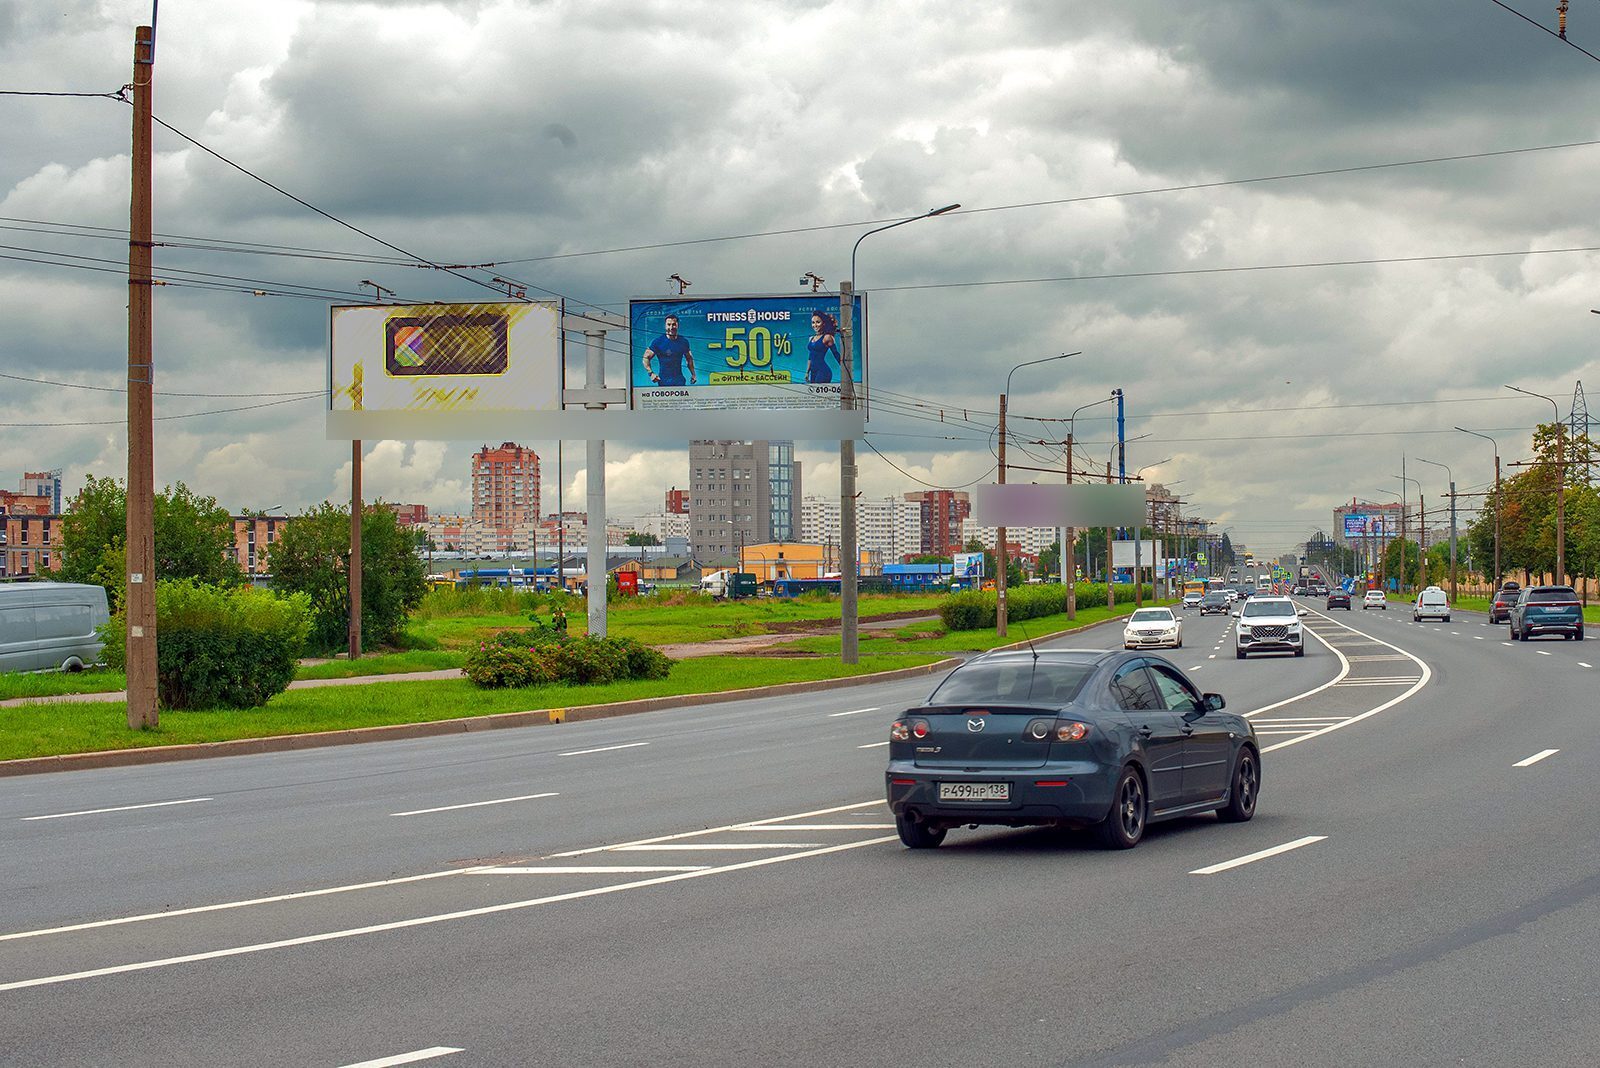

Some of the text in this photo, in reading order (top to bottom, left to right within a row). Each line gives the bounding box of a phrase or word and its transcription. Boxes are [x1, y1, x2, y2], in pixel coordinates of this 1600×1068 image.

[707, 311, 791, 322] FITNESS HOUSE
[755, 373, 788, 381] БАССЕЙН
